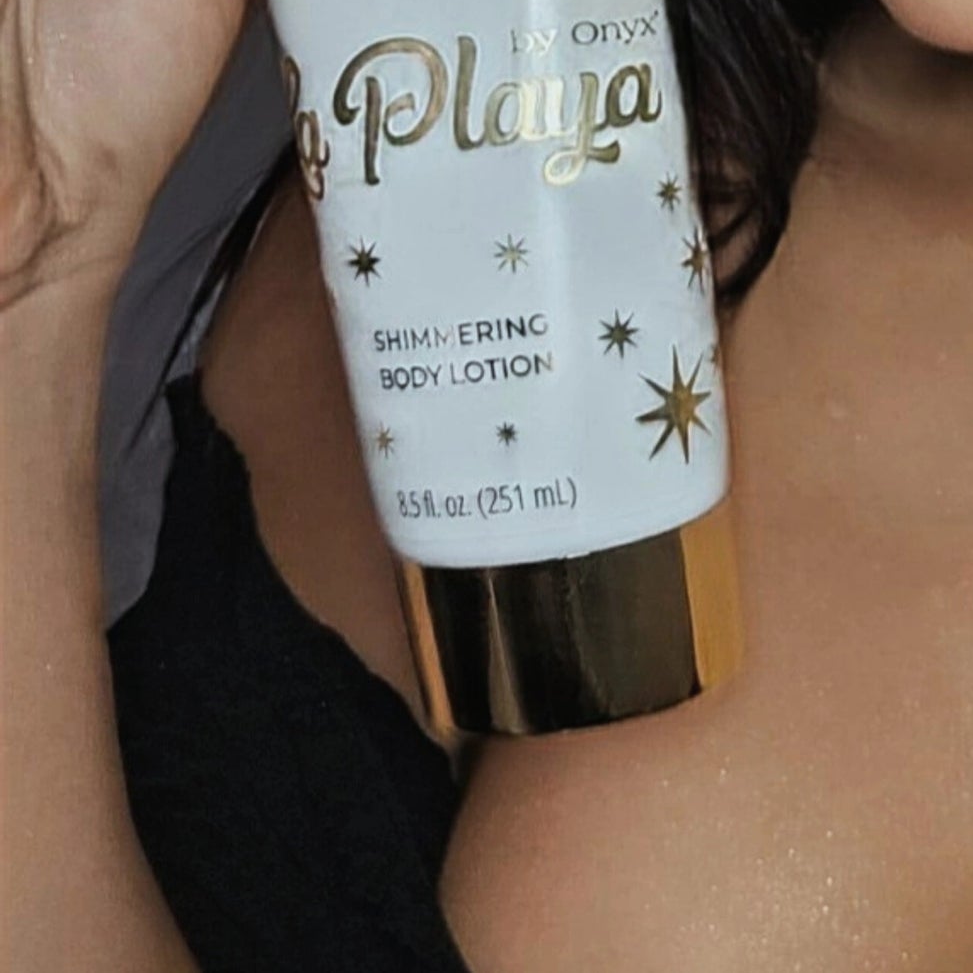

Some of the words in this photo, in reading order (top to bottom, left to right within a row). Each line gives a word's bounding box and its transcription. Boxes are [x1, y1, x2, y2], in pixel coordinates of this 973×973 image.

[511, 28, 557, 58] by
[333, 35, 662, 186] Playa
[373, 313, 549, 352] SHIMMERING
[379, 363, 443, 391] BODY
[450, 351, 553, 385] LOTION
[445, 494, 472, 517] oz.
[477, 483, 525, 520] (251
[534, 476, 577, 509] mL)
